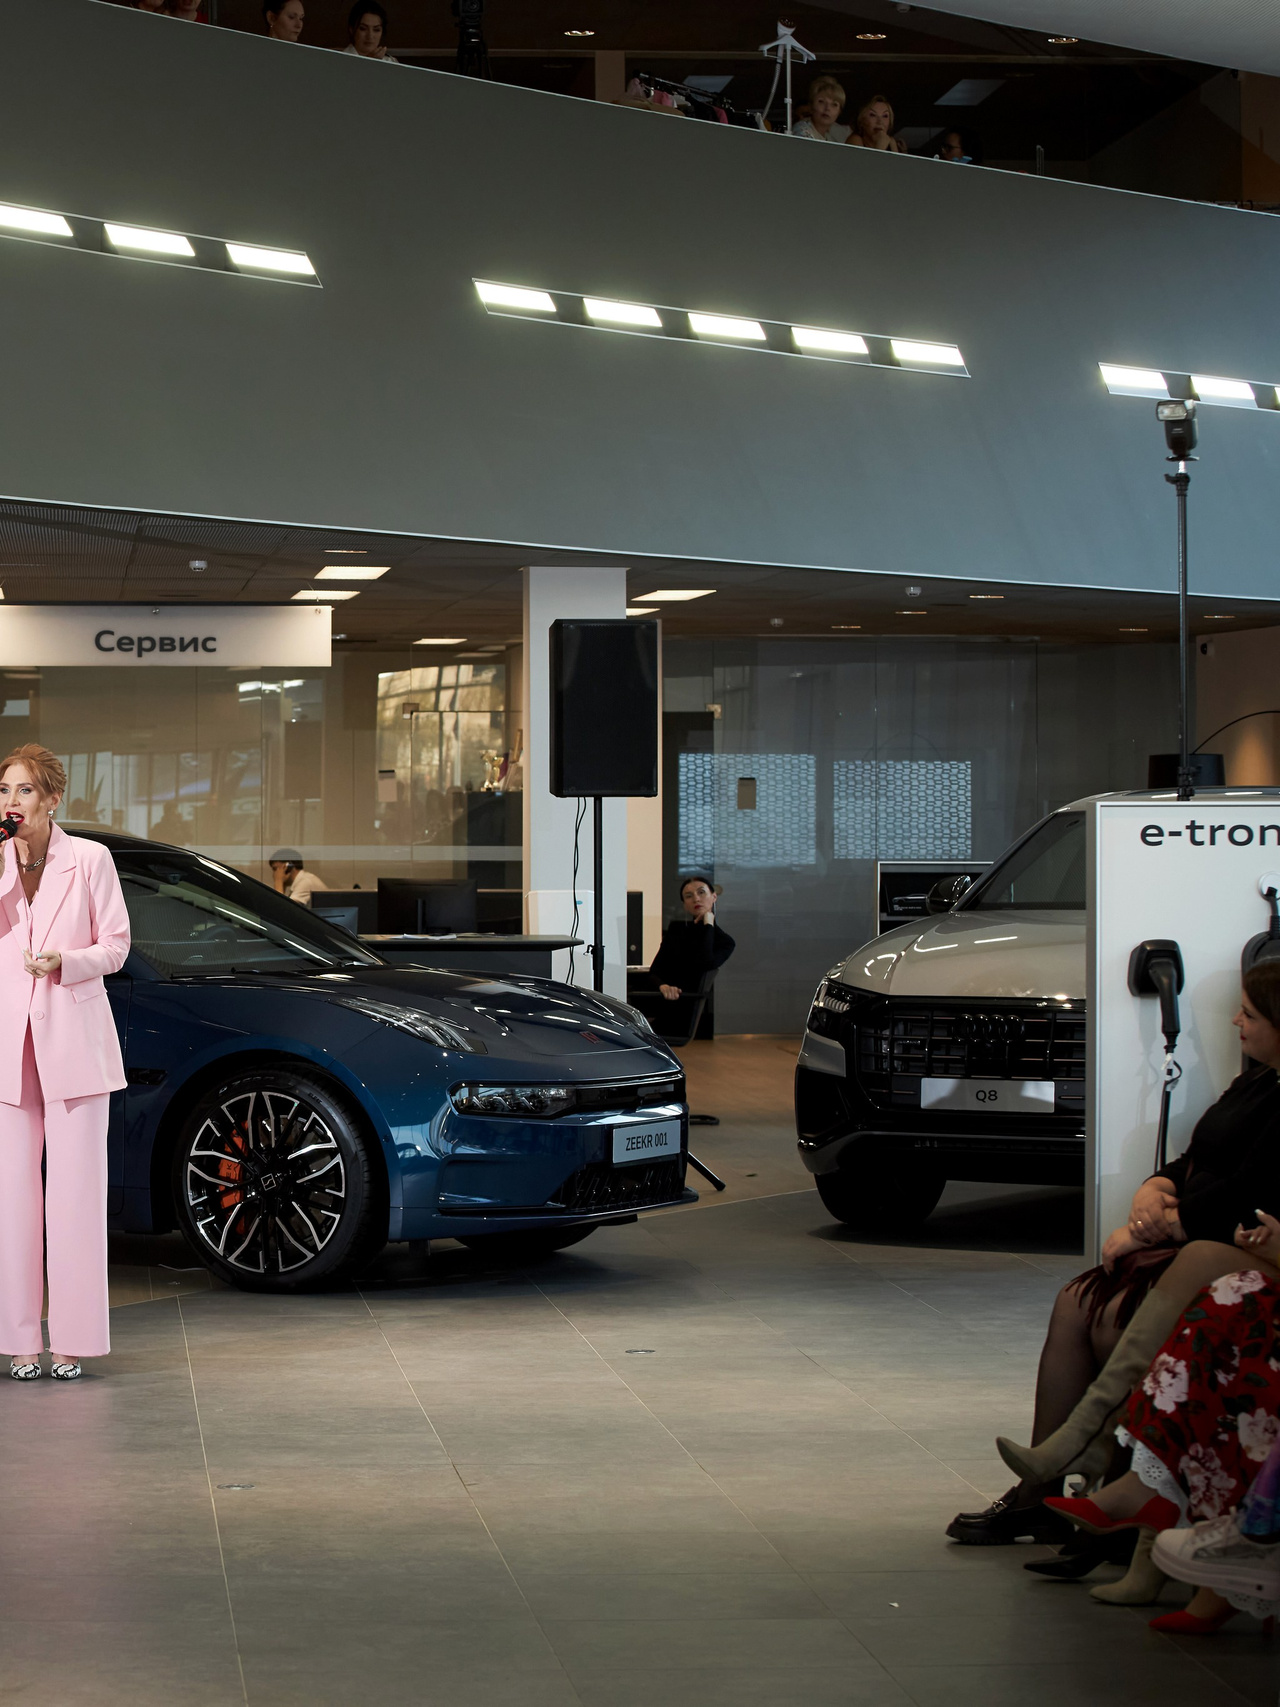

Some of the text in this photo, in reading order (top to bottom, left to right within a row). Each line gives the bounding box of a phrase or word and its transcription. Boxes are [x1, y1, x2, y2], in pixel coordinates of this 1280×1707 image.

[94, 630, 217, 658] Сервис
[1140, 820, 1280, 846] e-tron
[975, 1089, 998, 1103] Q8
[625, 1132, 668, 1151] ZEEKR 001
